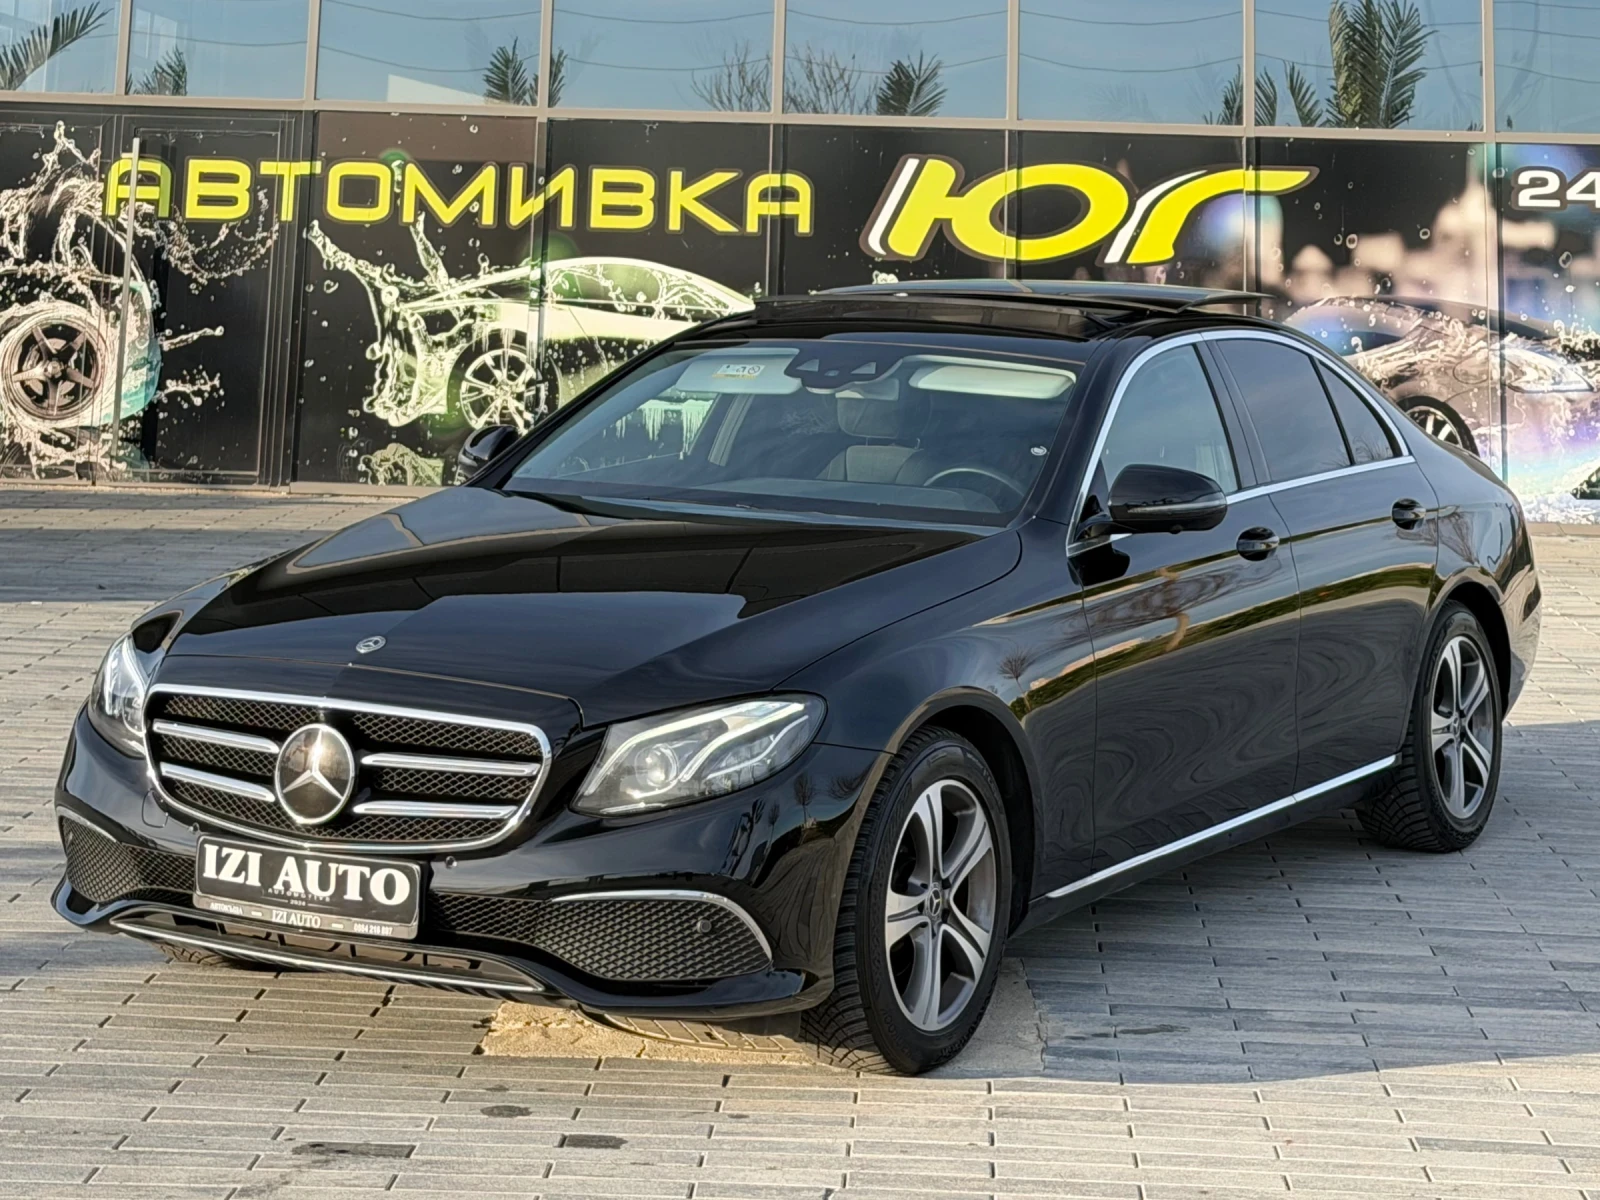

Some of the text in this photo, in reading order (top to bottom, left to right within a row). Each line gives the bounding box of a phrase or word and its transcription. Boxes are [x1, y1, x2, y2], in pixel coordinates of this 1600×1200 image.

[104, 156, 1311, 264] АВТОМИВКА ЮГ
[203, 844, 411, 906] IZI AUTO
[271, 910, 321, 929] IZI AUTO
